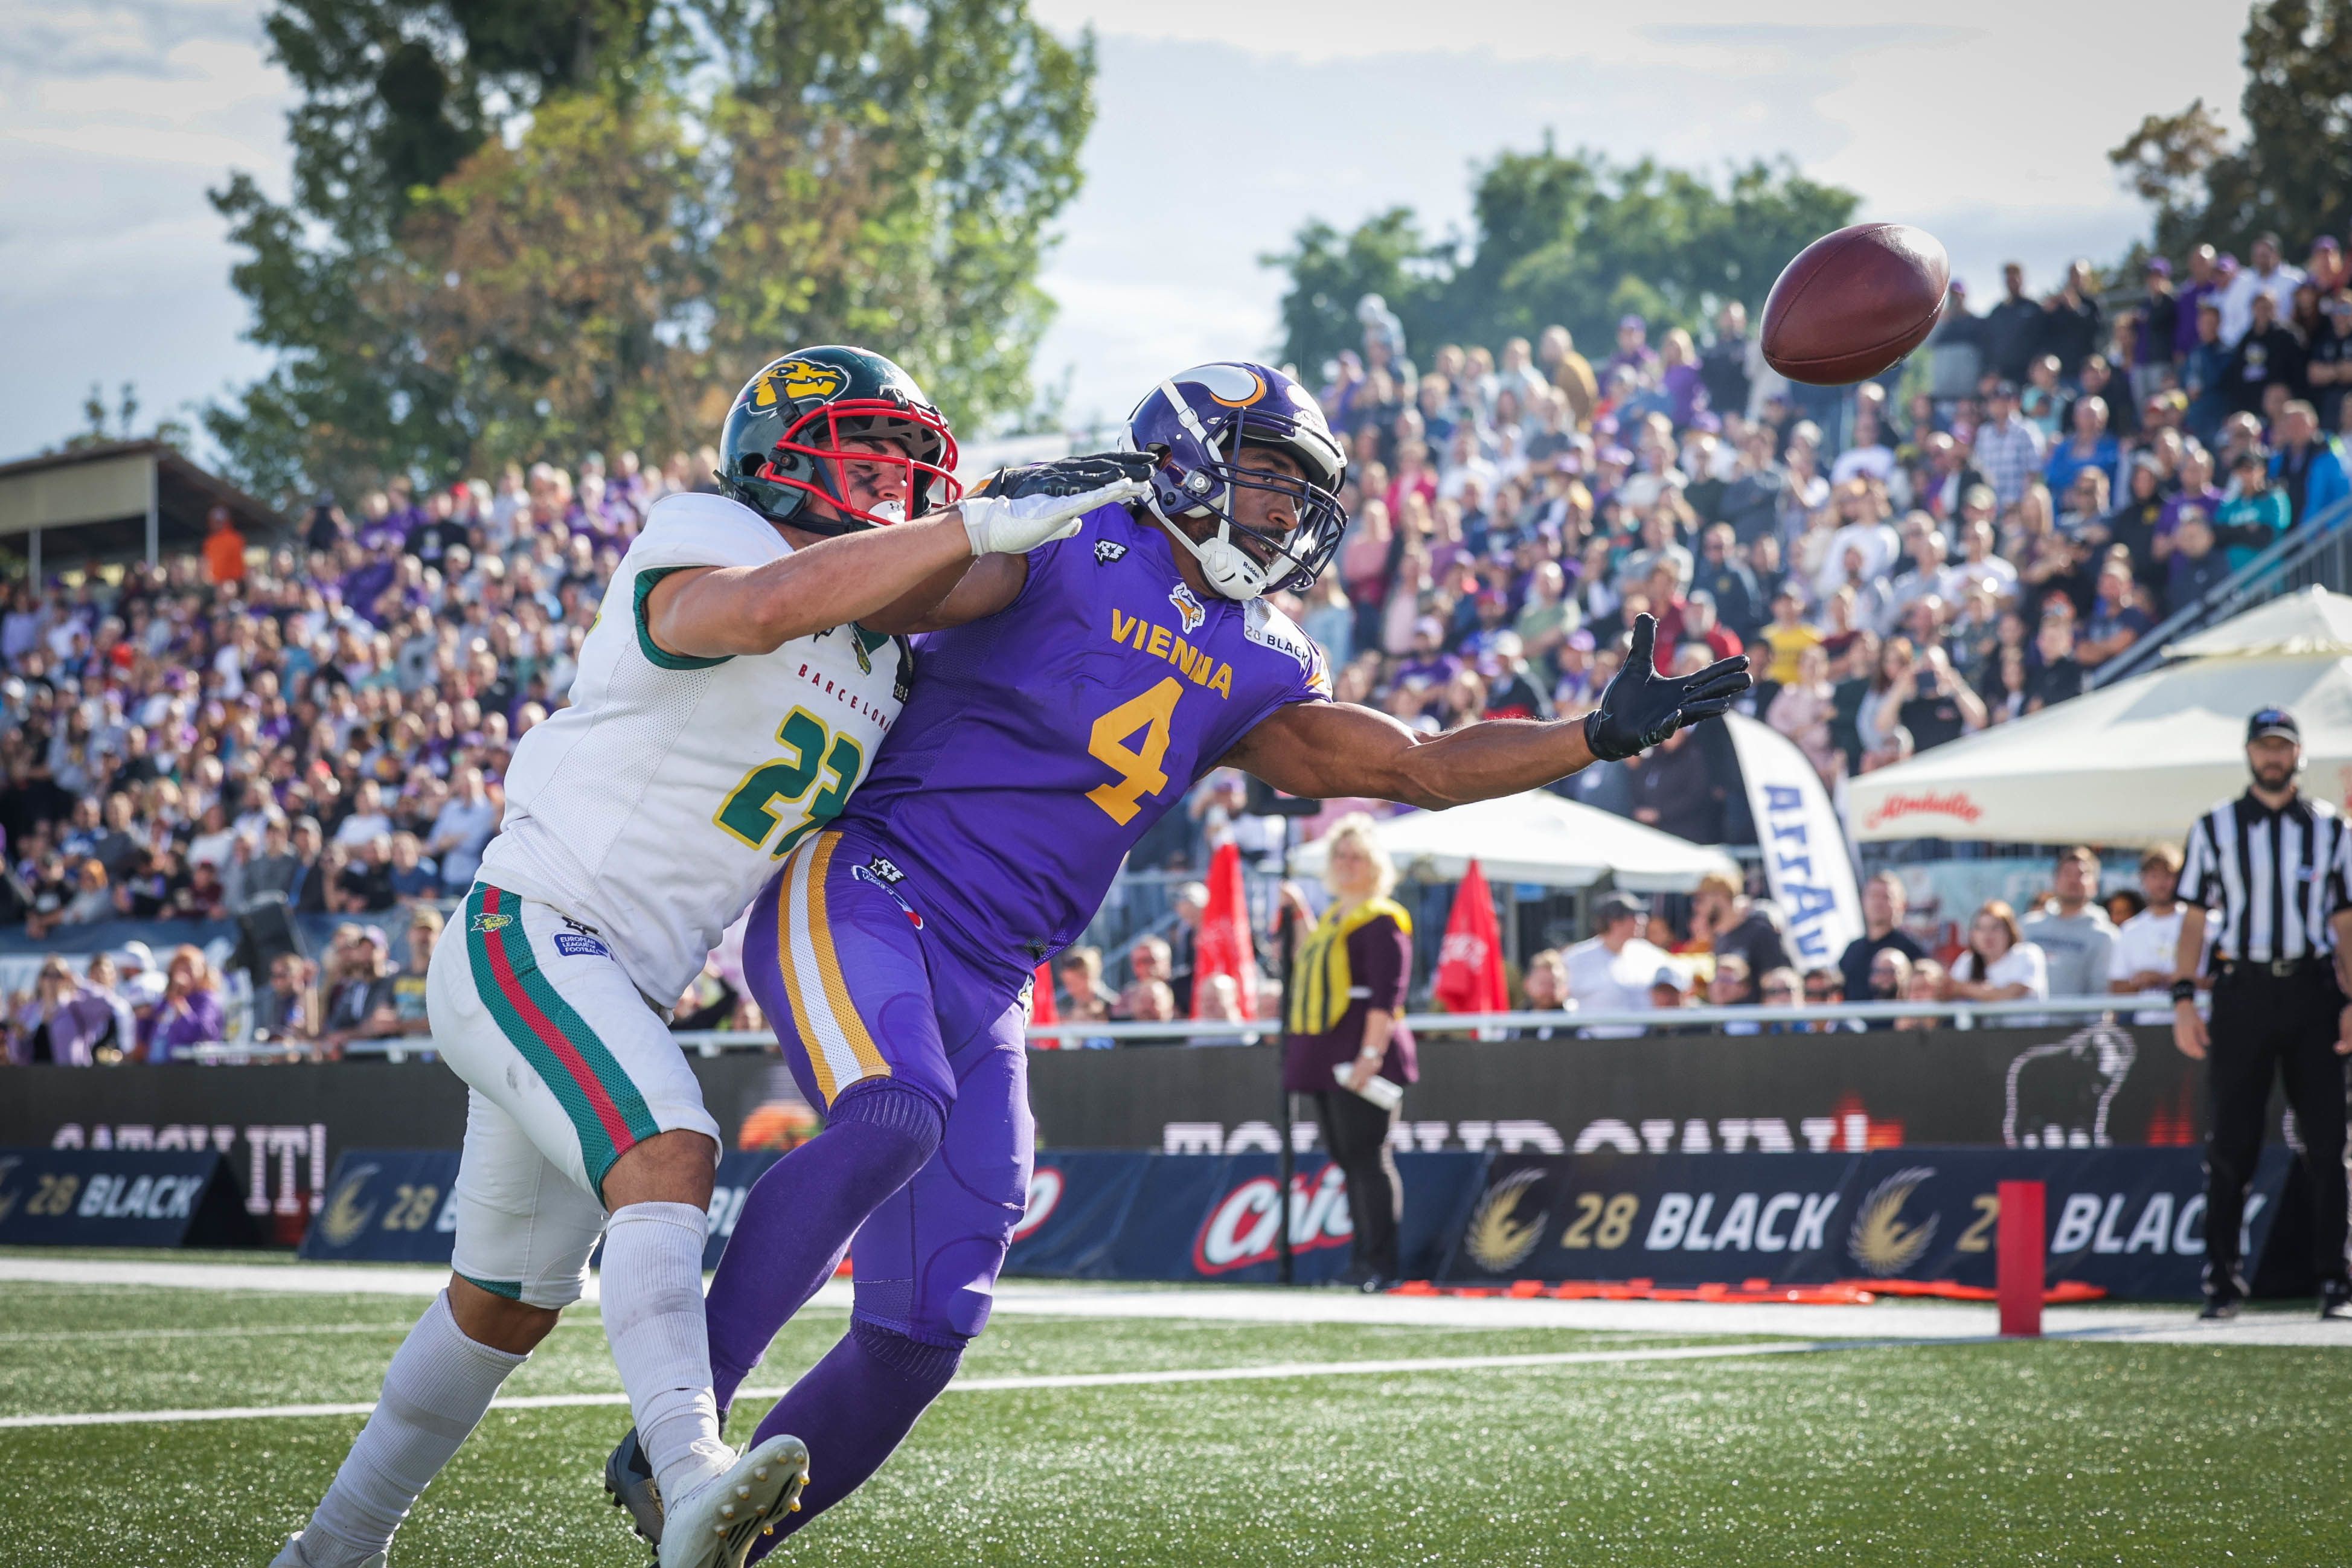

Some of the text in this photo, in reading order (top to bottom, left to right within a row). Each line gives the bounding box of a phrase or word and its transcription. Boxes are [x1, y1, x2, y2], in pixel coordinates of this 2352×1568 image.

[1111, 609, 1233, 700] VIENNA
[1245, 626, 1309, 665] 28 BLACK
[798, 664, 891, 733] BARCELONA
[895, 683, 904, 698] 28
[1085, 676, 1184, 826] 4
[560, 936, 595, 945] EUROPEAN
[27, 1173, 204, 1218] 28 BLACK
[245, 1123, 326, 1215] IT!
[383, 1183, 439, 1231] 28
[1562, 1192, 1842, 1252] 28 BLACK
[1956, 1193, 1999, 1252] 2
